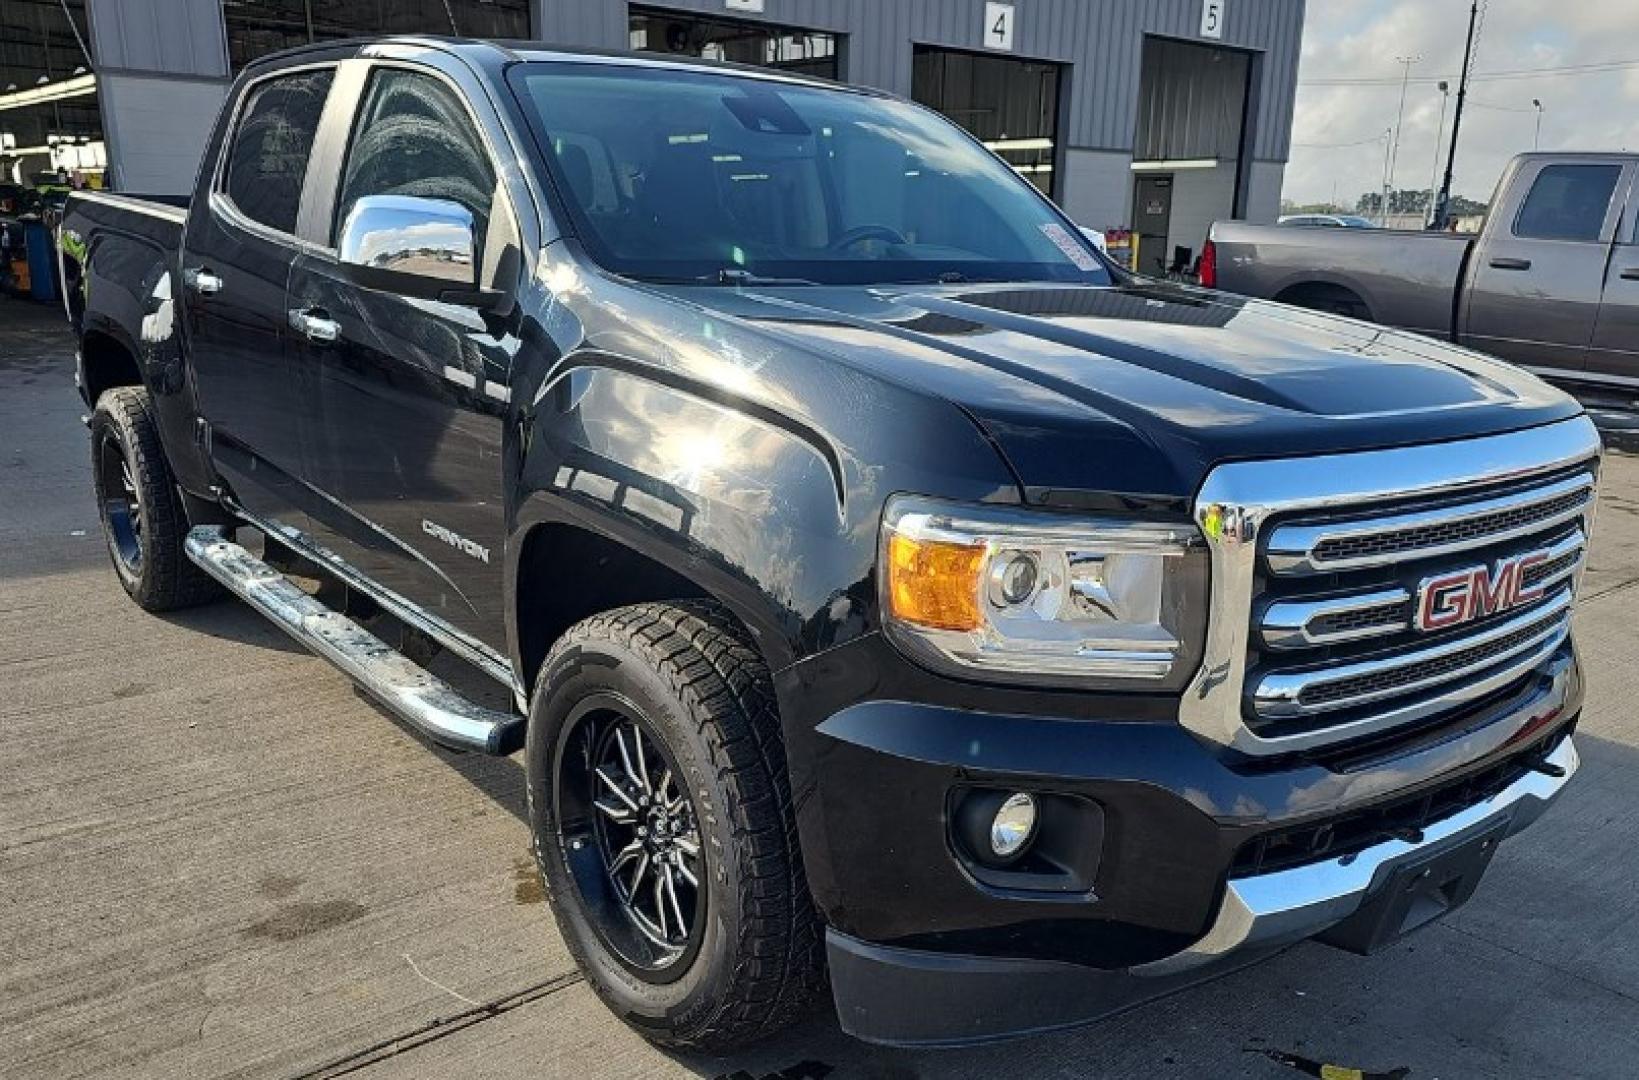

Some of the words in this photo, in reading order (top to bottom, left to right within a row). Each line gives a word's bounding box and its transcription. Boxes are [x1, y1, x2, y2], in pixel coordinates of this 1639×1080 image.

[991, 11, 1006, 44] 4
[1207, 4, 1218, 31] 5
[422, 518, 490, 564] CANYON
[1416, 548, 1550, 632] GMC
